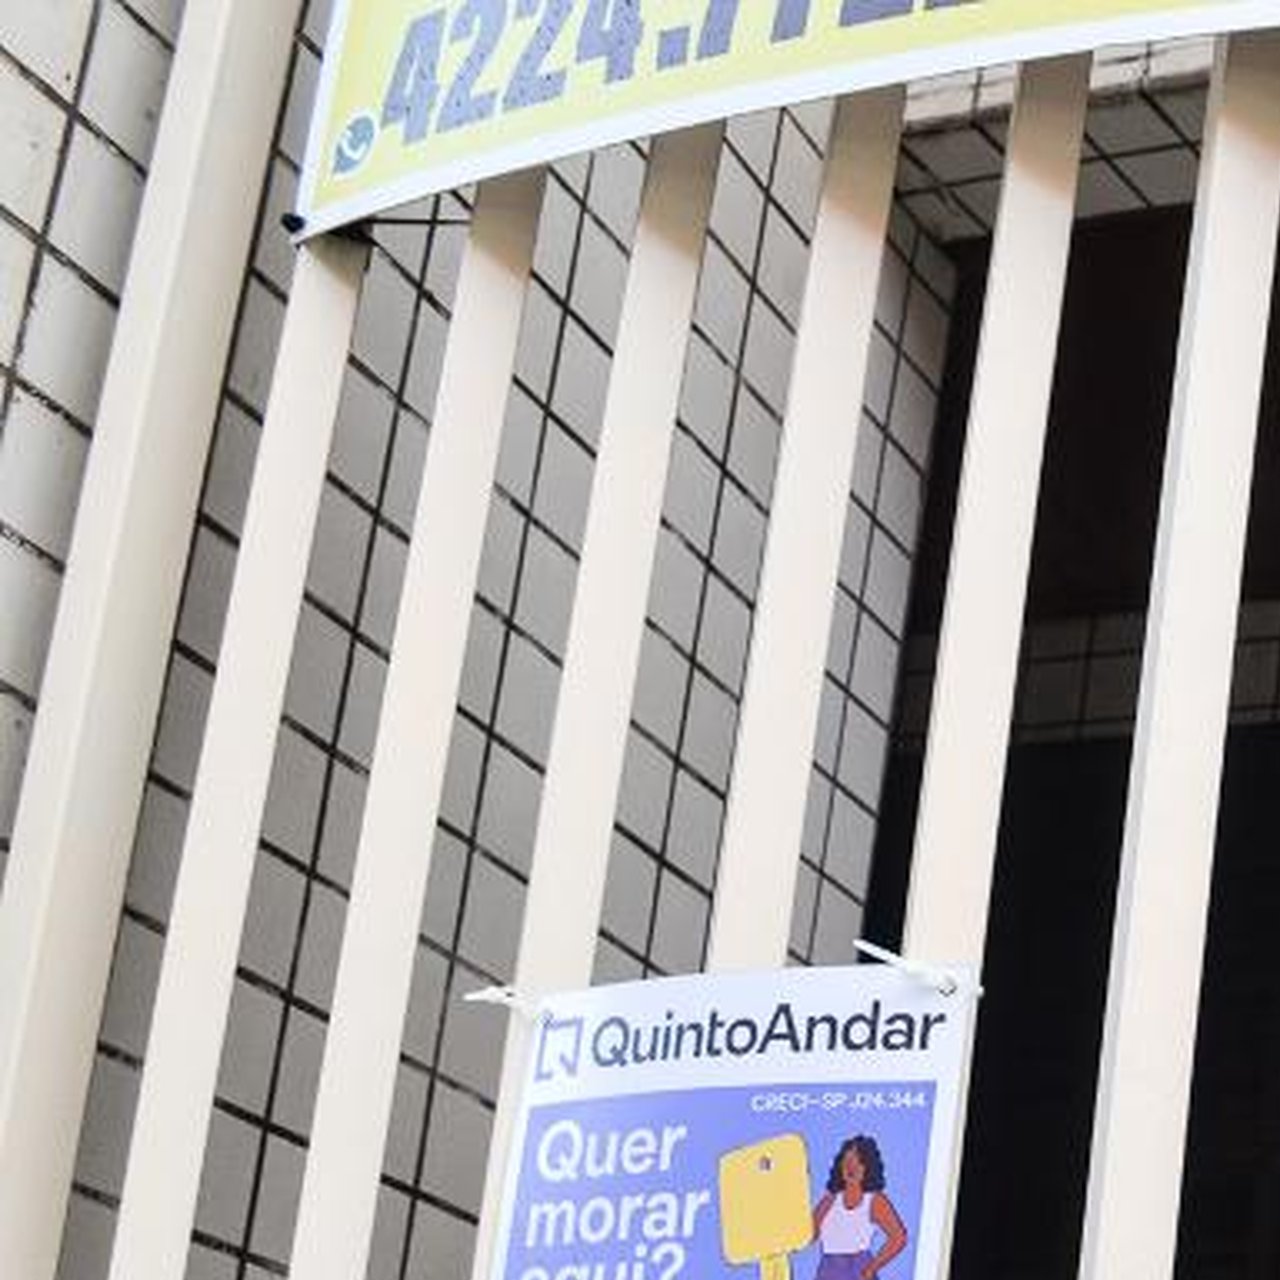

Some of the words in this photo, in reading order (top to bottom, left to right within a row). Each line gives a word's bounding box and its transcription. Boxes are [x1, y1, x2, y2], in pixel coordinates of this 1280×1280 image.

[379, 0, 982, 145] 4224.
[591, 1000, 946, 1067] QuintoAndar
[536, 1119, 688, 1182] Quer
[525, 1190, 711, 1248] morar
